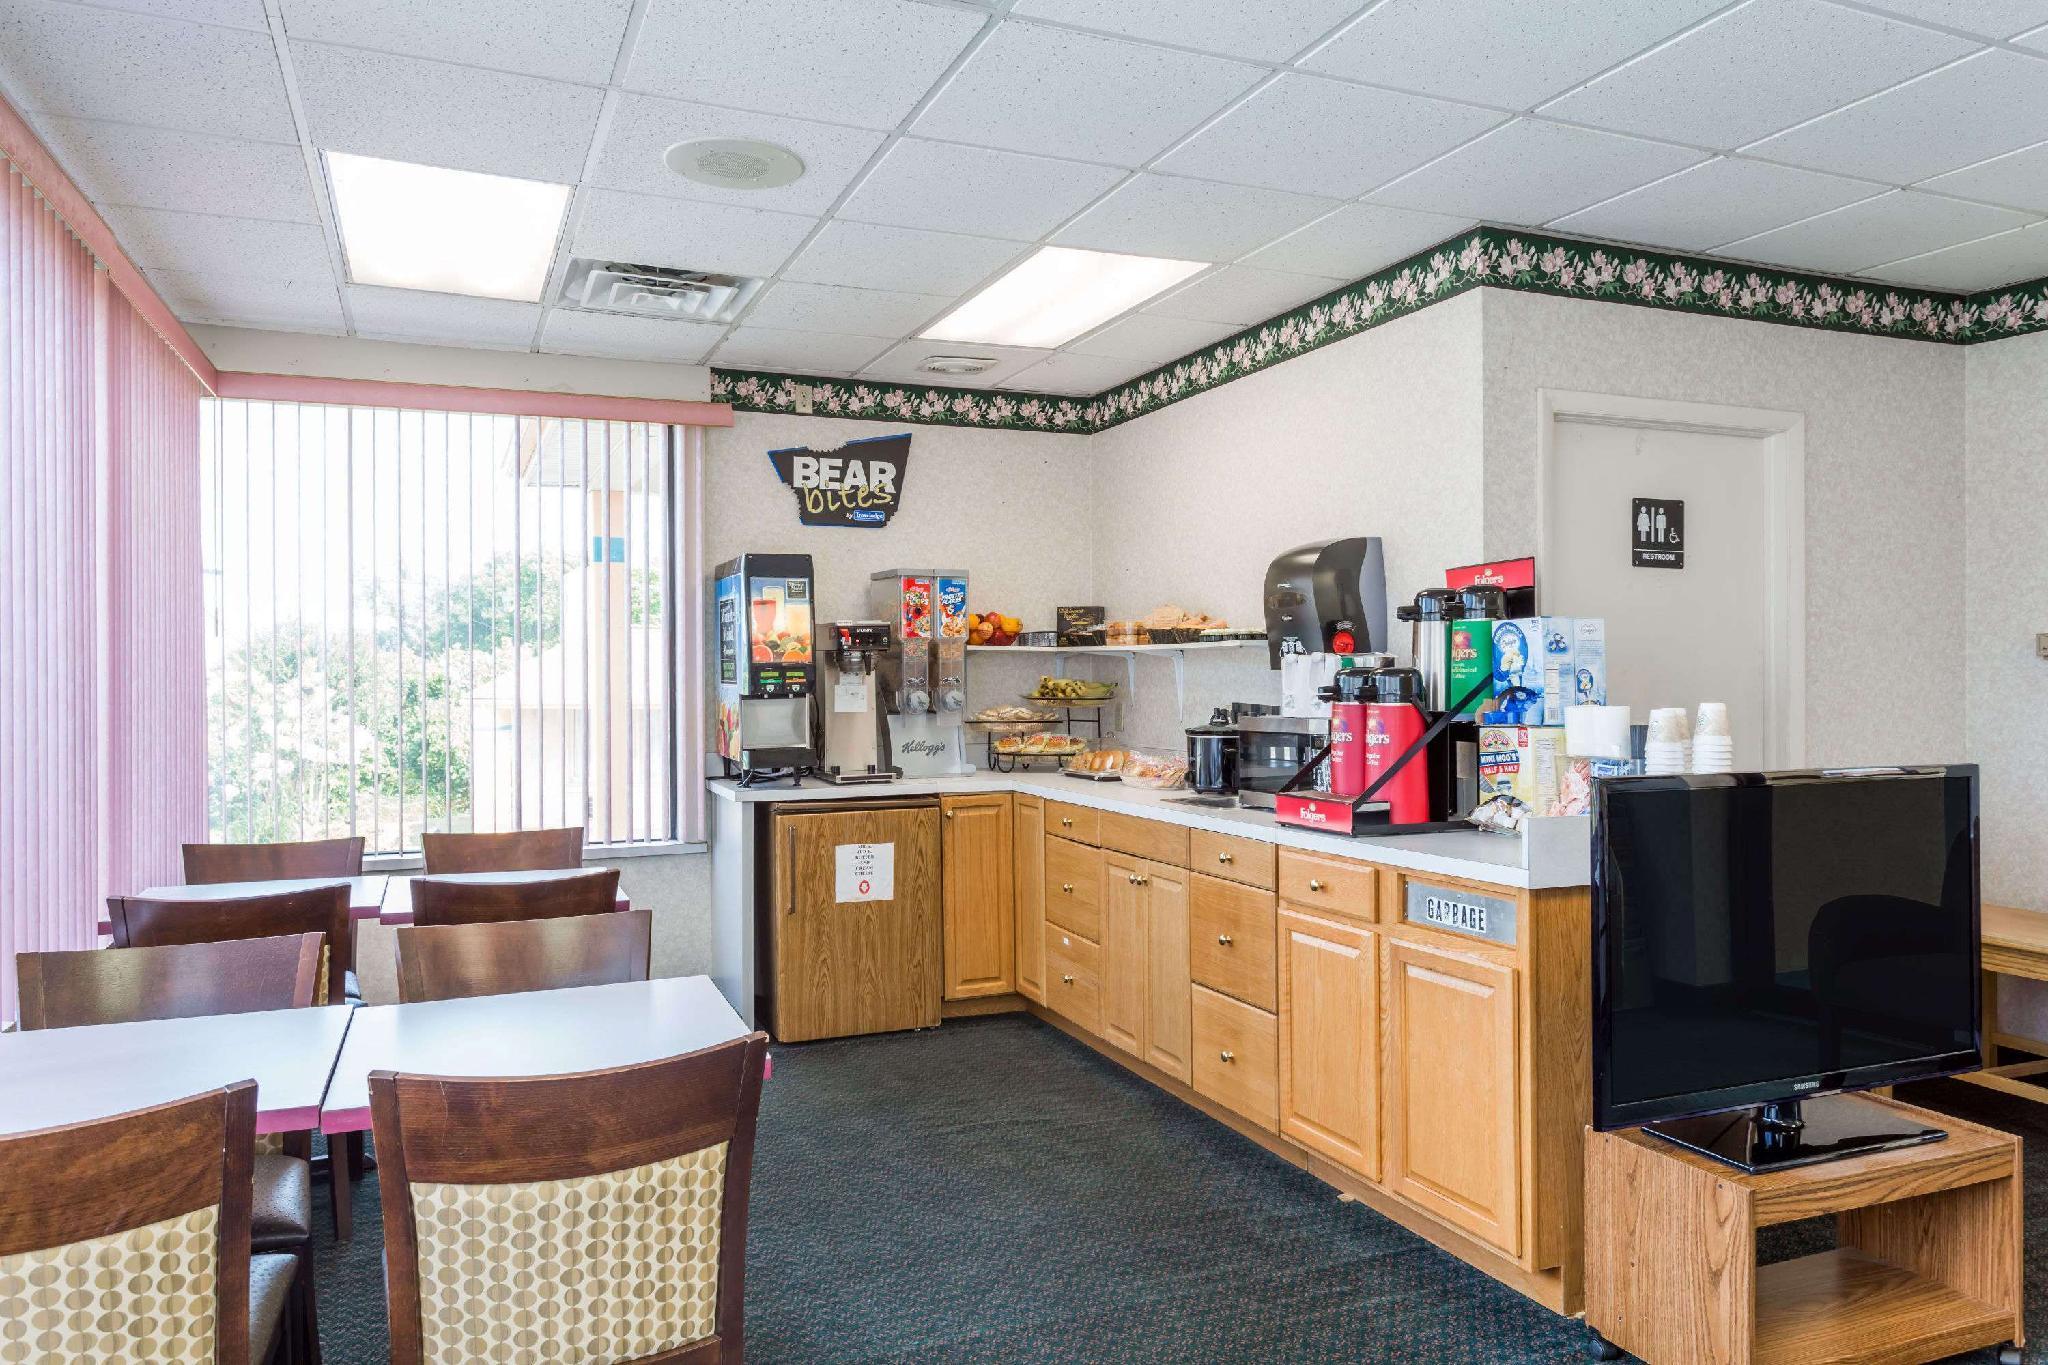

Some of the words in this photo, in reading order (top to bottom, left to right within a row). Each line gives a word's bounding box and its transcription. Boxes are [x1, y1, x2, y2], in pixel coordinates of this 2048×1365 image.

[793, 456, 896, 493] BEAR
[801, 480, 892, 514] bites
[1642, 553, 1676, 561] RESTROOM
[1474, 574, 1503, 586] Folgers
[902, 739, 946, 756] Kellogg's
[1484, 766, 1498, 774] HALF
[1504, 764, 1519, 772] HALF
[1300, 807, 1327, 824] Folgers
[1793, 1081, 1820, 1091] SAMSUNG
